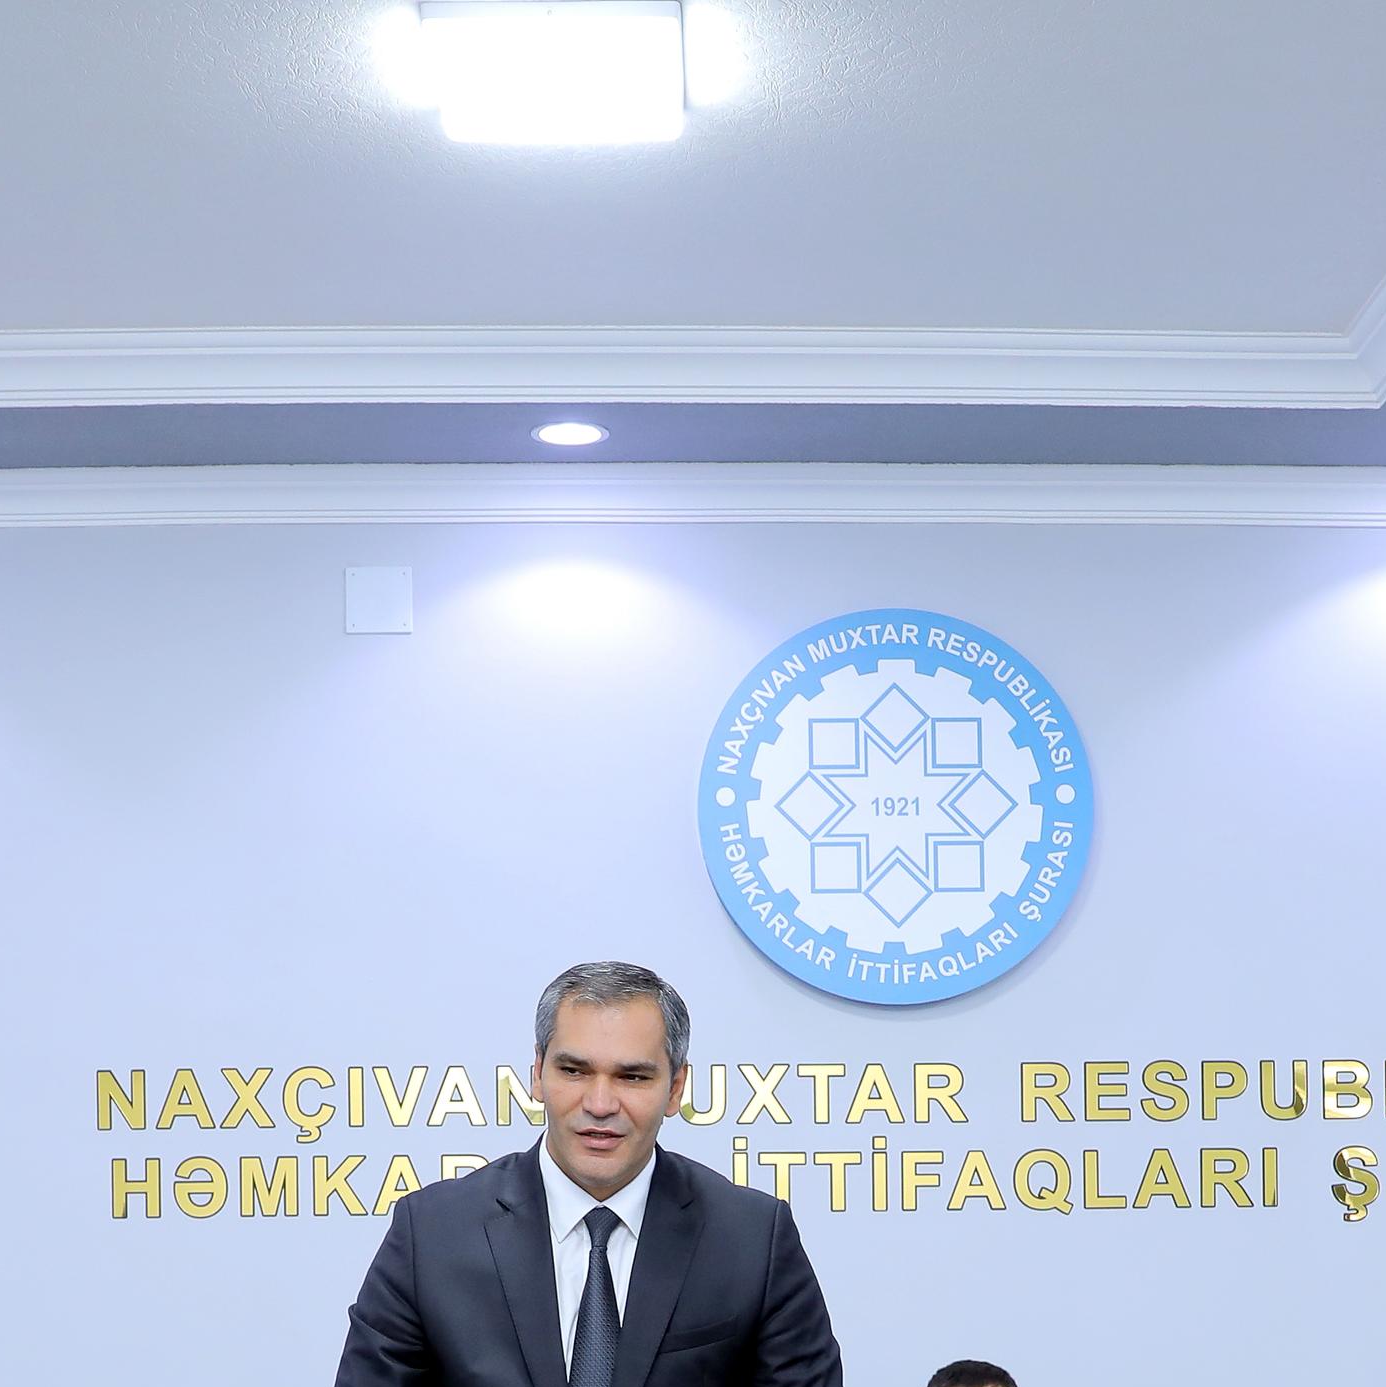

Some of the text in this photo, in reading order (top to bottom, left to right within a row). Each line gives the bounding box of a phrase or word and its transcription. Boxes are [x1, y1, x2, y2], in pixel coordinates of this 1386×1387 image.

[716, 624, 1074, 775] NAXÇIVAN MUXTAR RESPUBLİKASI
[871, 796, 920, 817] 1921
[847, 922, 1019, 984] İTTİFAQLARI
[1018, 821, 1074, 923] ŞURASI
[95, 1064, 545, 1144] NAXÇIVAN
[679, 1061, 969, 1125] UXTAR
[732, 1136, 1279, 1216] İTTİFAQLARI
